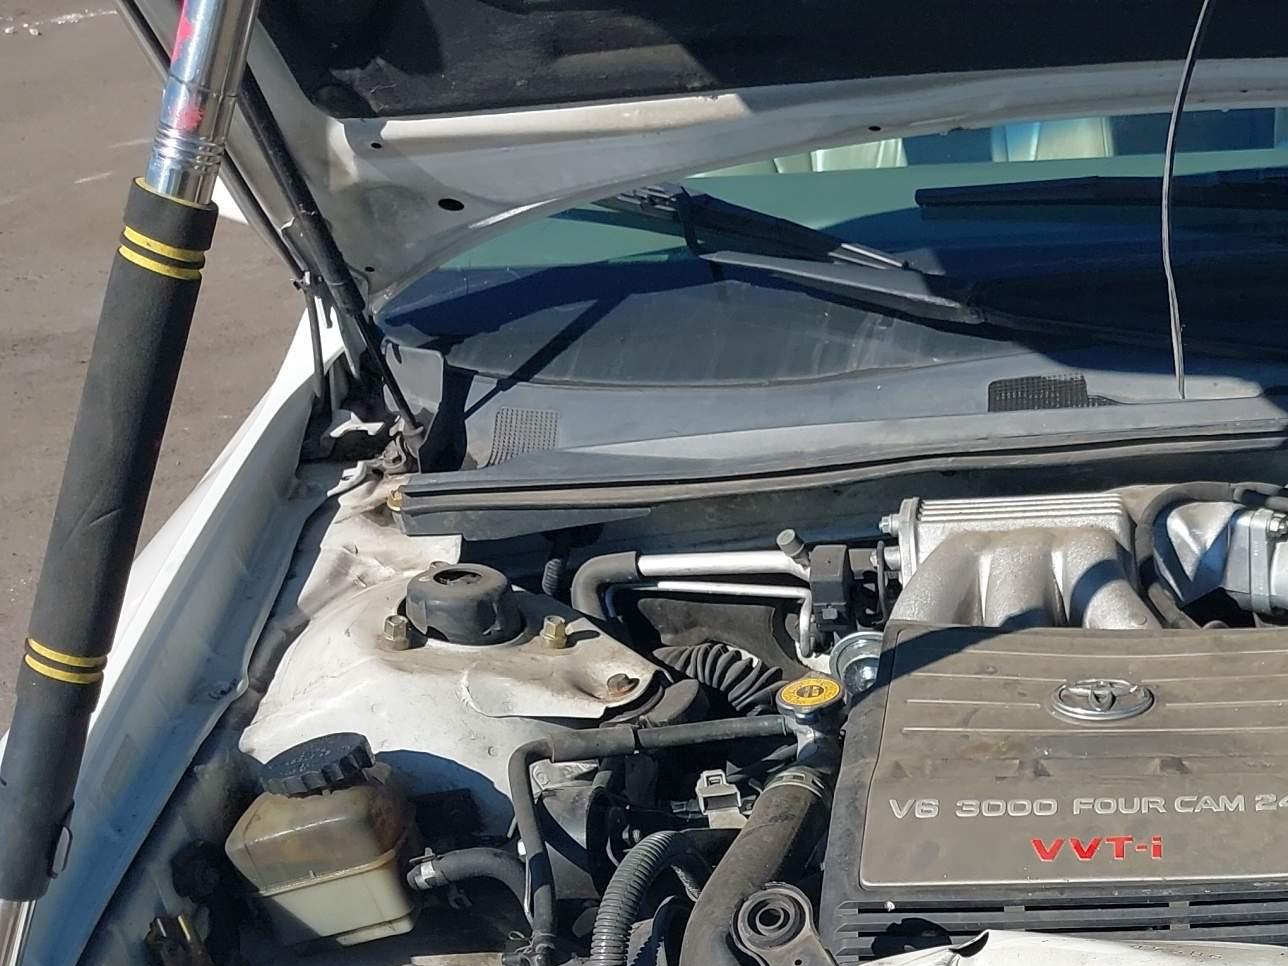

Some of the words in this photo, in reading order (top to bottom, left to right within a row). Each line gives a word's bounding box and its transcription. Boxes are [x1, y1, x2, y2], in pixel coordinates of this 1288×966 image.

[889, 799, 939, 818] V6
[955, 799, 1057, 817] 3000
[1073, 797, 1166, 814] FOUR
[1175, 794, 1244, 812] CAM
[1031, 835, 1164, 862] VVT-i
